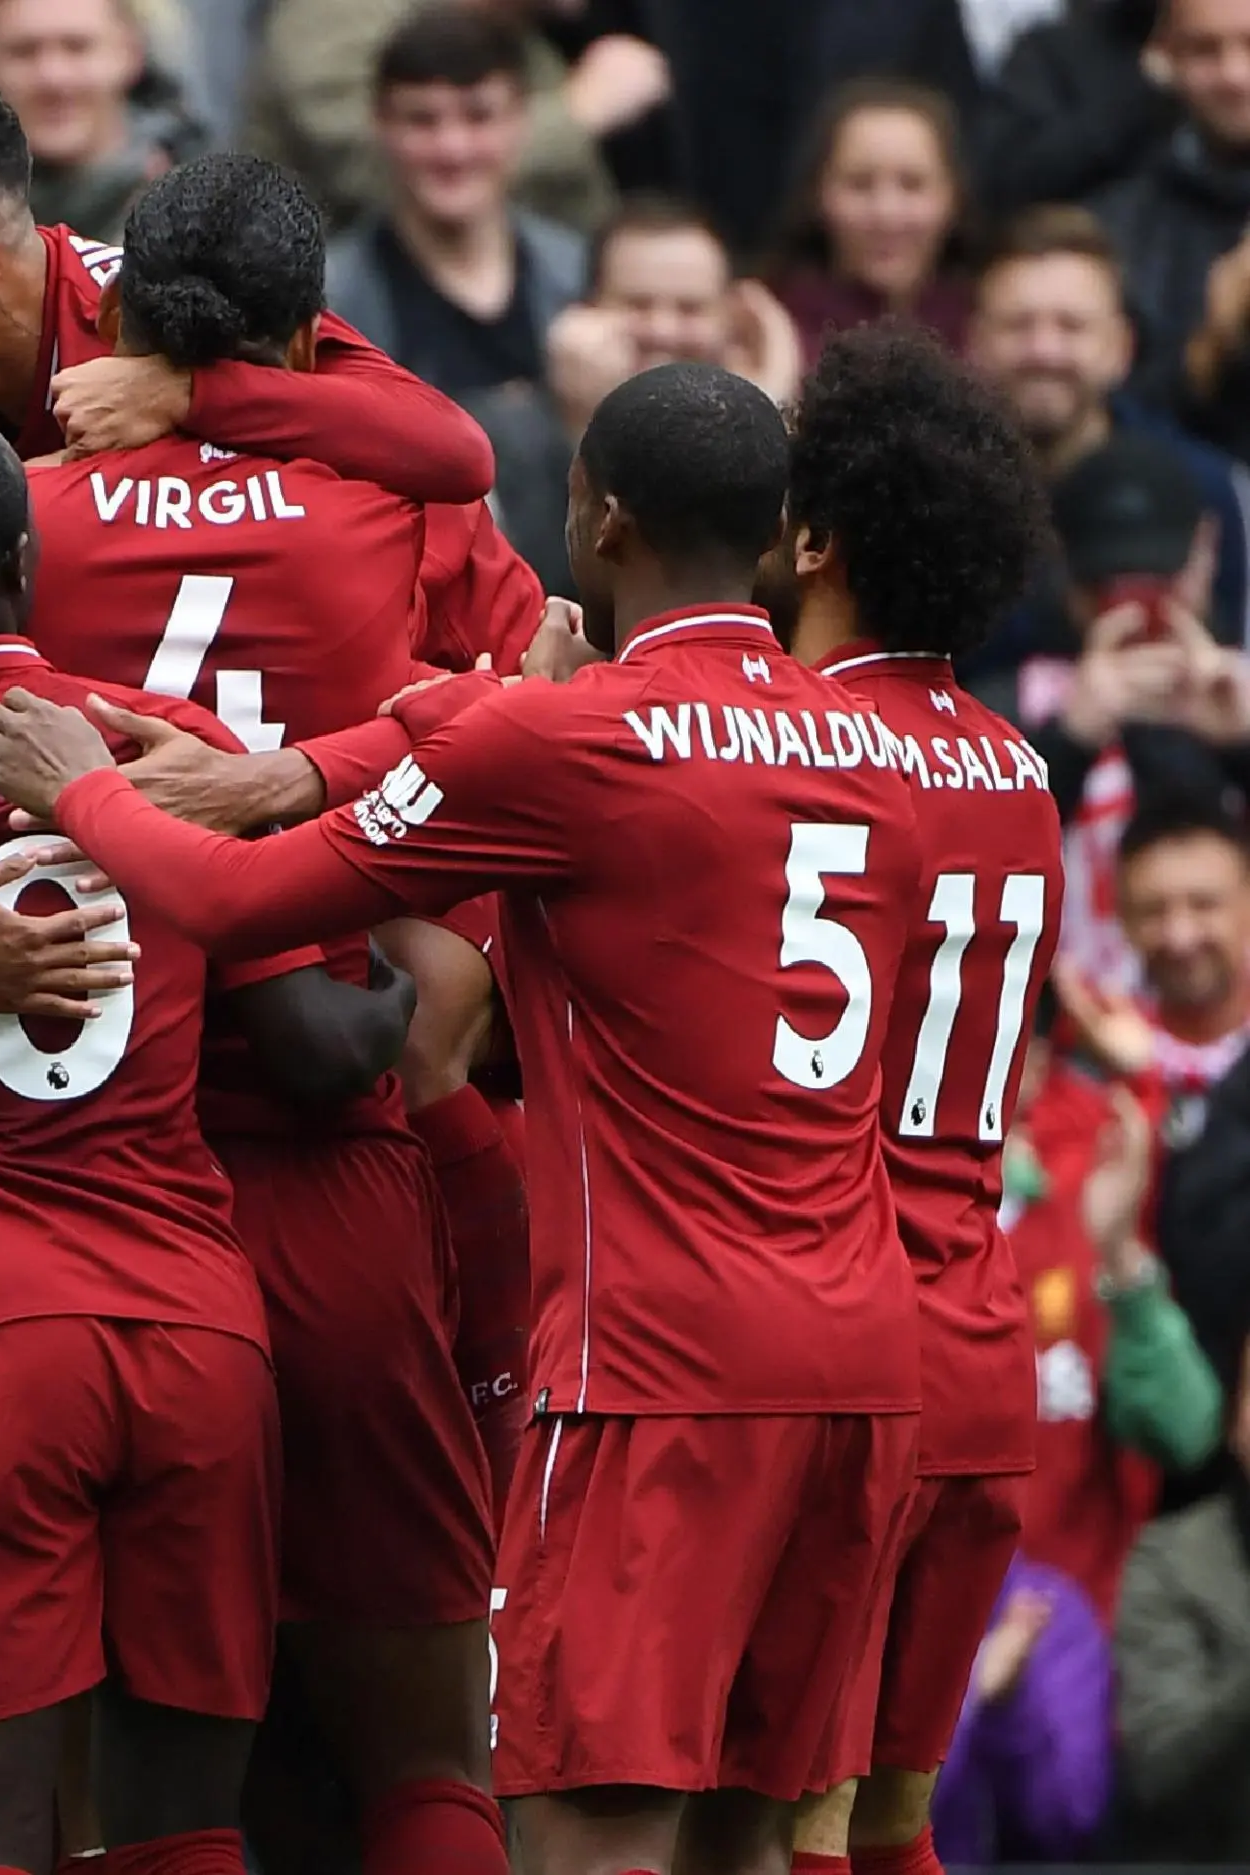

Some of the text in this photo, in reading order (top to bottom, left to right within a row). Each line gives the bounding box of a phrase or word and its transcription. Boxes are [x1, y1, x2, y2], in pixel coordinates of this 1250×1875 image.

[90, 470, 306, 529] VIRGIL
[142, 574, 286, 755] 4
[772, 822, 872, 1089] 5
[898, 873, 1046, 1141] 11
